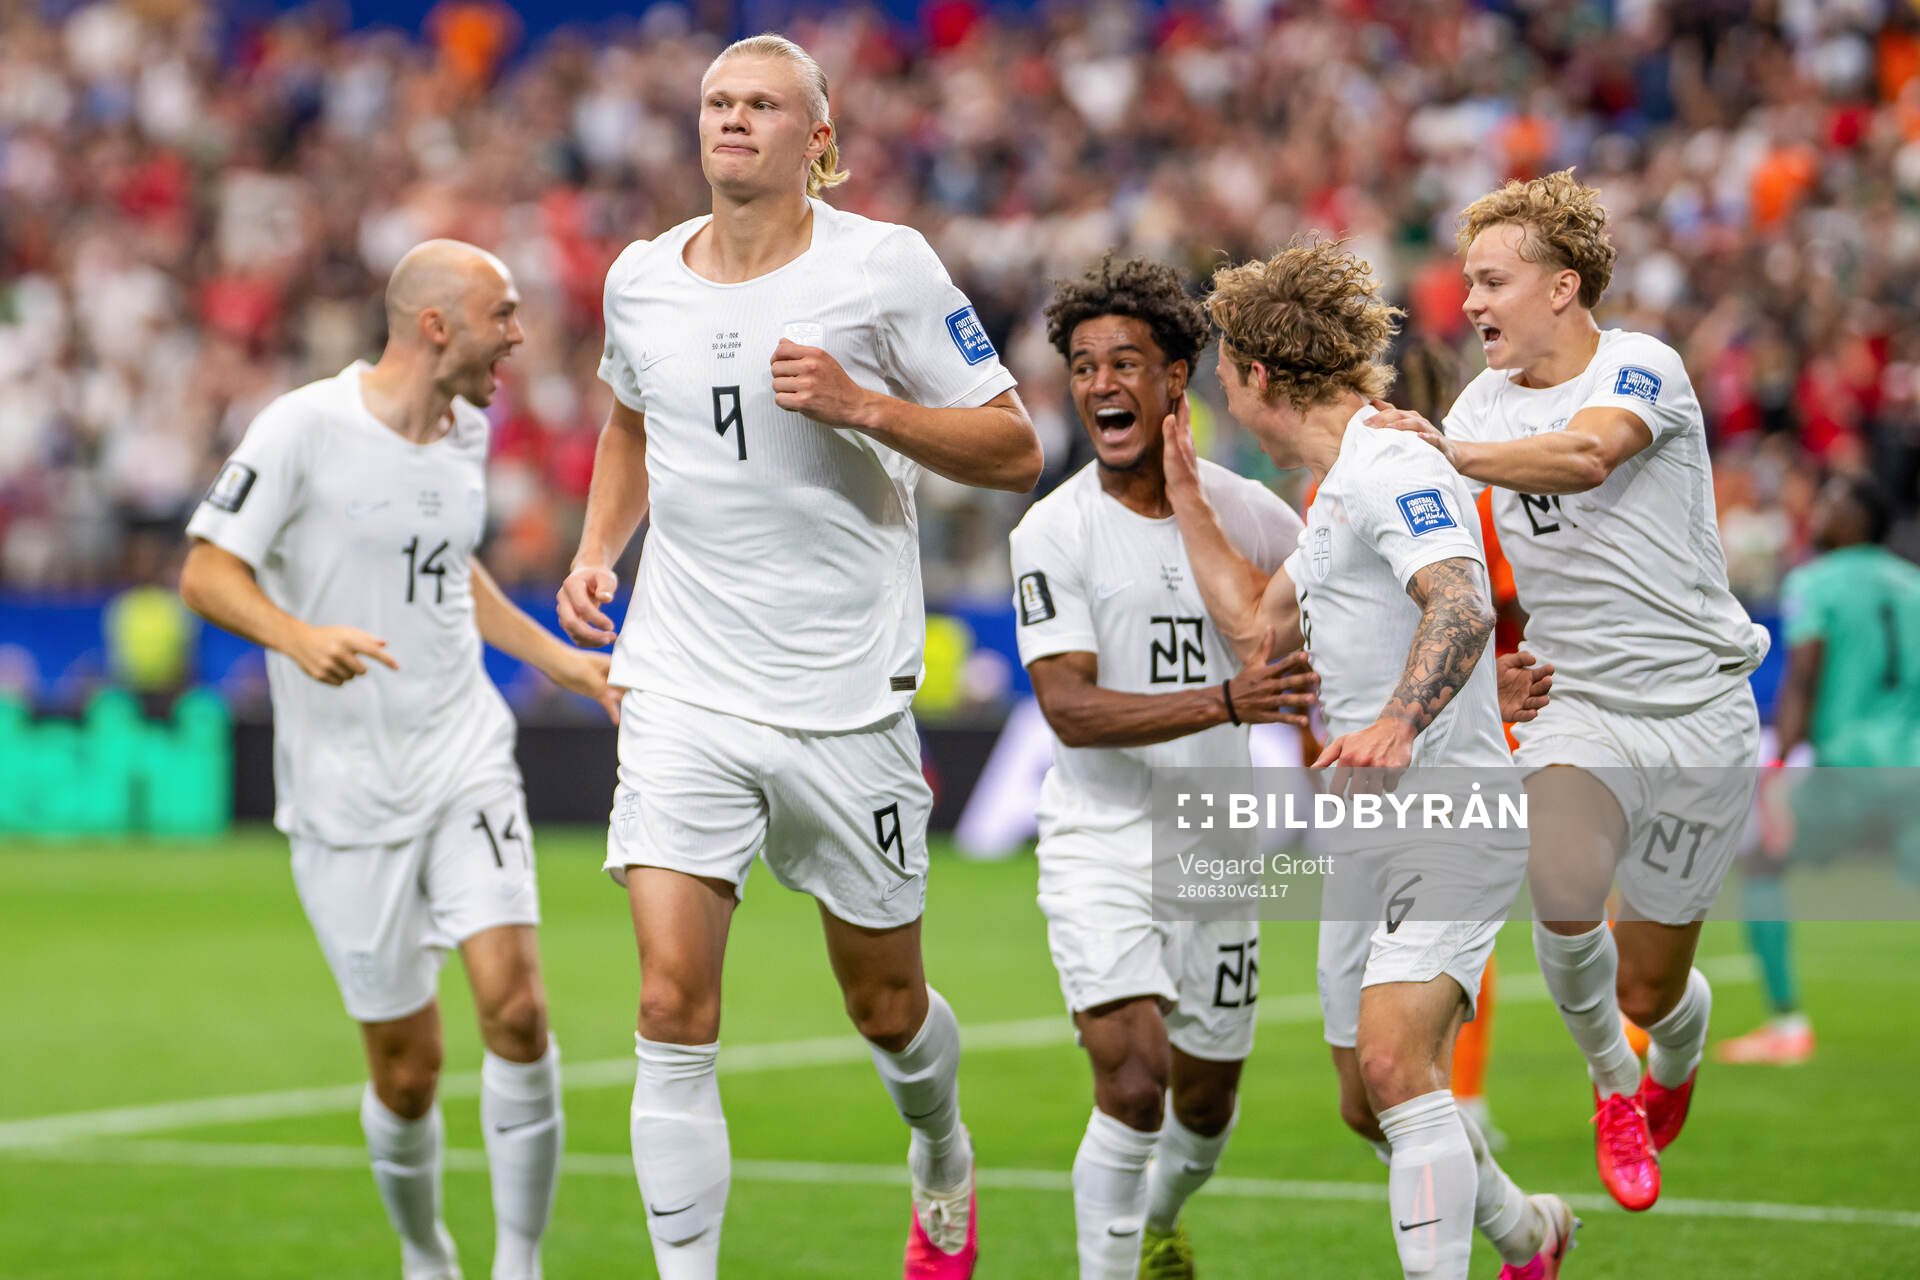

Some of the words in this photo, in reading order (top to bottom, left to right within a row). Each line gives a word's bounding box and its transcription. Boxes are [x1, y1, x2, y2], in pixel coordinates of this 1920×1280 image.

[1627, 370, 1654, 385] FOOTBALL
[712, 384, 747, 460] 9
[1407, 497, 1435, 508] FOOTBALL
[1410, 502, 1440, 517] UNITES
[1413, 515, 1425, 525] the
[1425, 511, 1446, 520] World
[403, 535, 449, 603] 14
[1150, 616, 1206, 683] 22
[472, 811, 529, 869] 14
[873, 801, 905, 870] 9
[1386, 874, 1422, 934] 6
